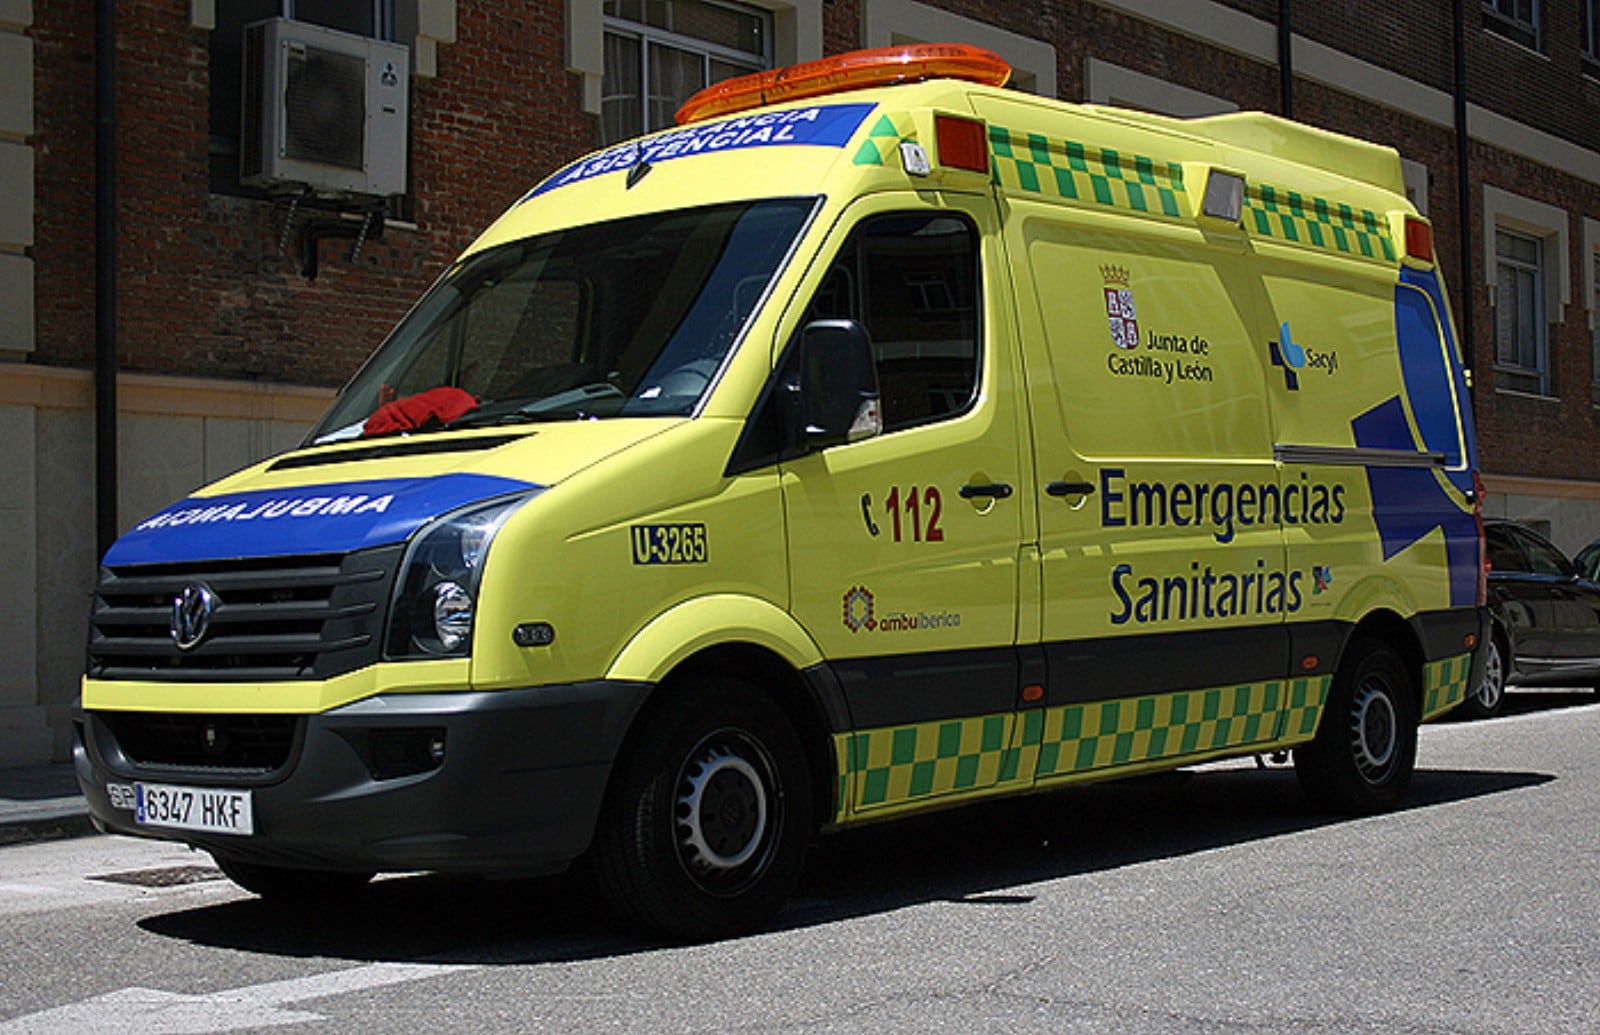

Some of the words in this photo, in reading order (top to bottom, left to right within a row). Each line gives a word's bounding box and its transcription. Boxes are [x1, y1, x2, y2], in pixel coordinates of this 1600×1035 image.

[558, 124, 795, 184] ASISTENCIAL
[1147, 330, 1187, 353] Junta
[1191, 335, 1208, 356] de
[1306, 347, 1338, 375] Sacyl
[1108, 353, 1161, 378] Castilla
[1164, 361, 1174, 384] y
[1177, 359, 1212, 381] León
[886, 486, 945, 542] 112
[1100, 468, 1345, 543] Emergencias
[634, 526, 705, 563] U-3265
[1111, 559, 1302, 625] Sanitarias
[147, 790, 194, 823] 6347
[202, 793, 243, 828] HKF
